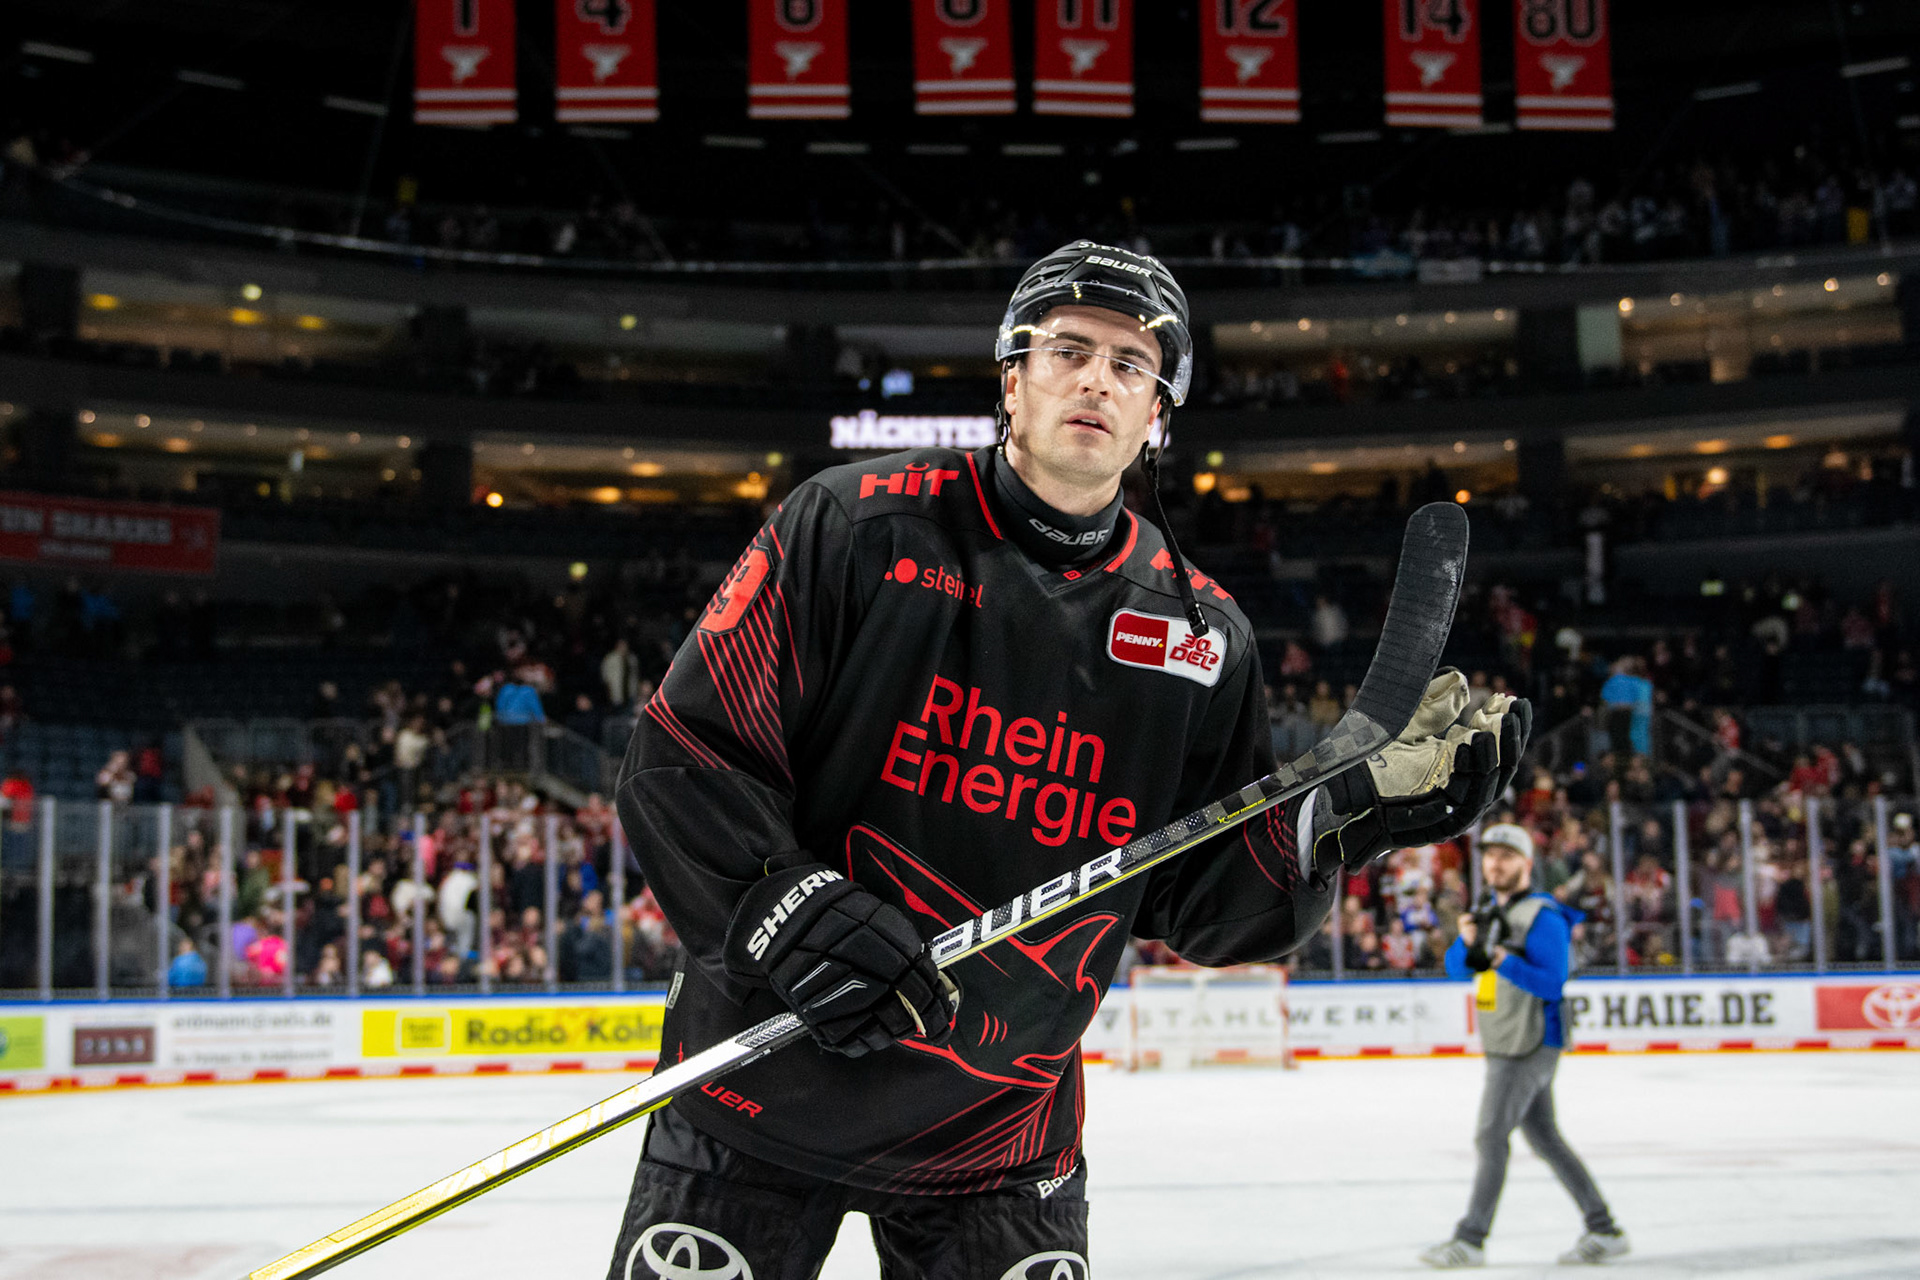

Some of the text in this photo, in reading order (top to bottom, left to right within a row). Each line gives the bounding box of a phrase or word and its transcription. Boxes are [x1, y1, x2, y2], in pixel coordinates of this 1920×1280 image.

[1400, 0, 1471, 43] 14
[1518, 0, 1605, 47] 80
[1085, 255, 1153, 278] BAUER
[1169, 646, 1220, 672] DEL
[920, 674, 1106, 784] Rhein
[880, 720, 1137, 848] Energie
[922, 847, 1123, 965] AUER
[1570, 991, 1776, 1028] P.HAIE.DE
[466, 1014, 567, 1046] Radio
[700, 1081, 764, 1118] UER
